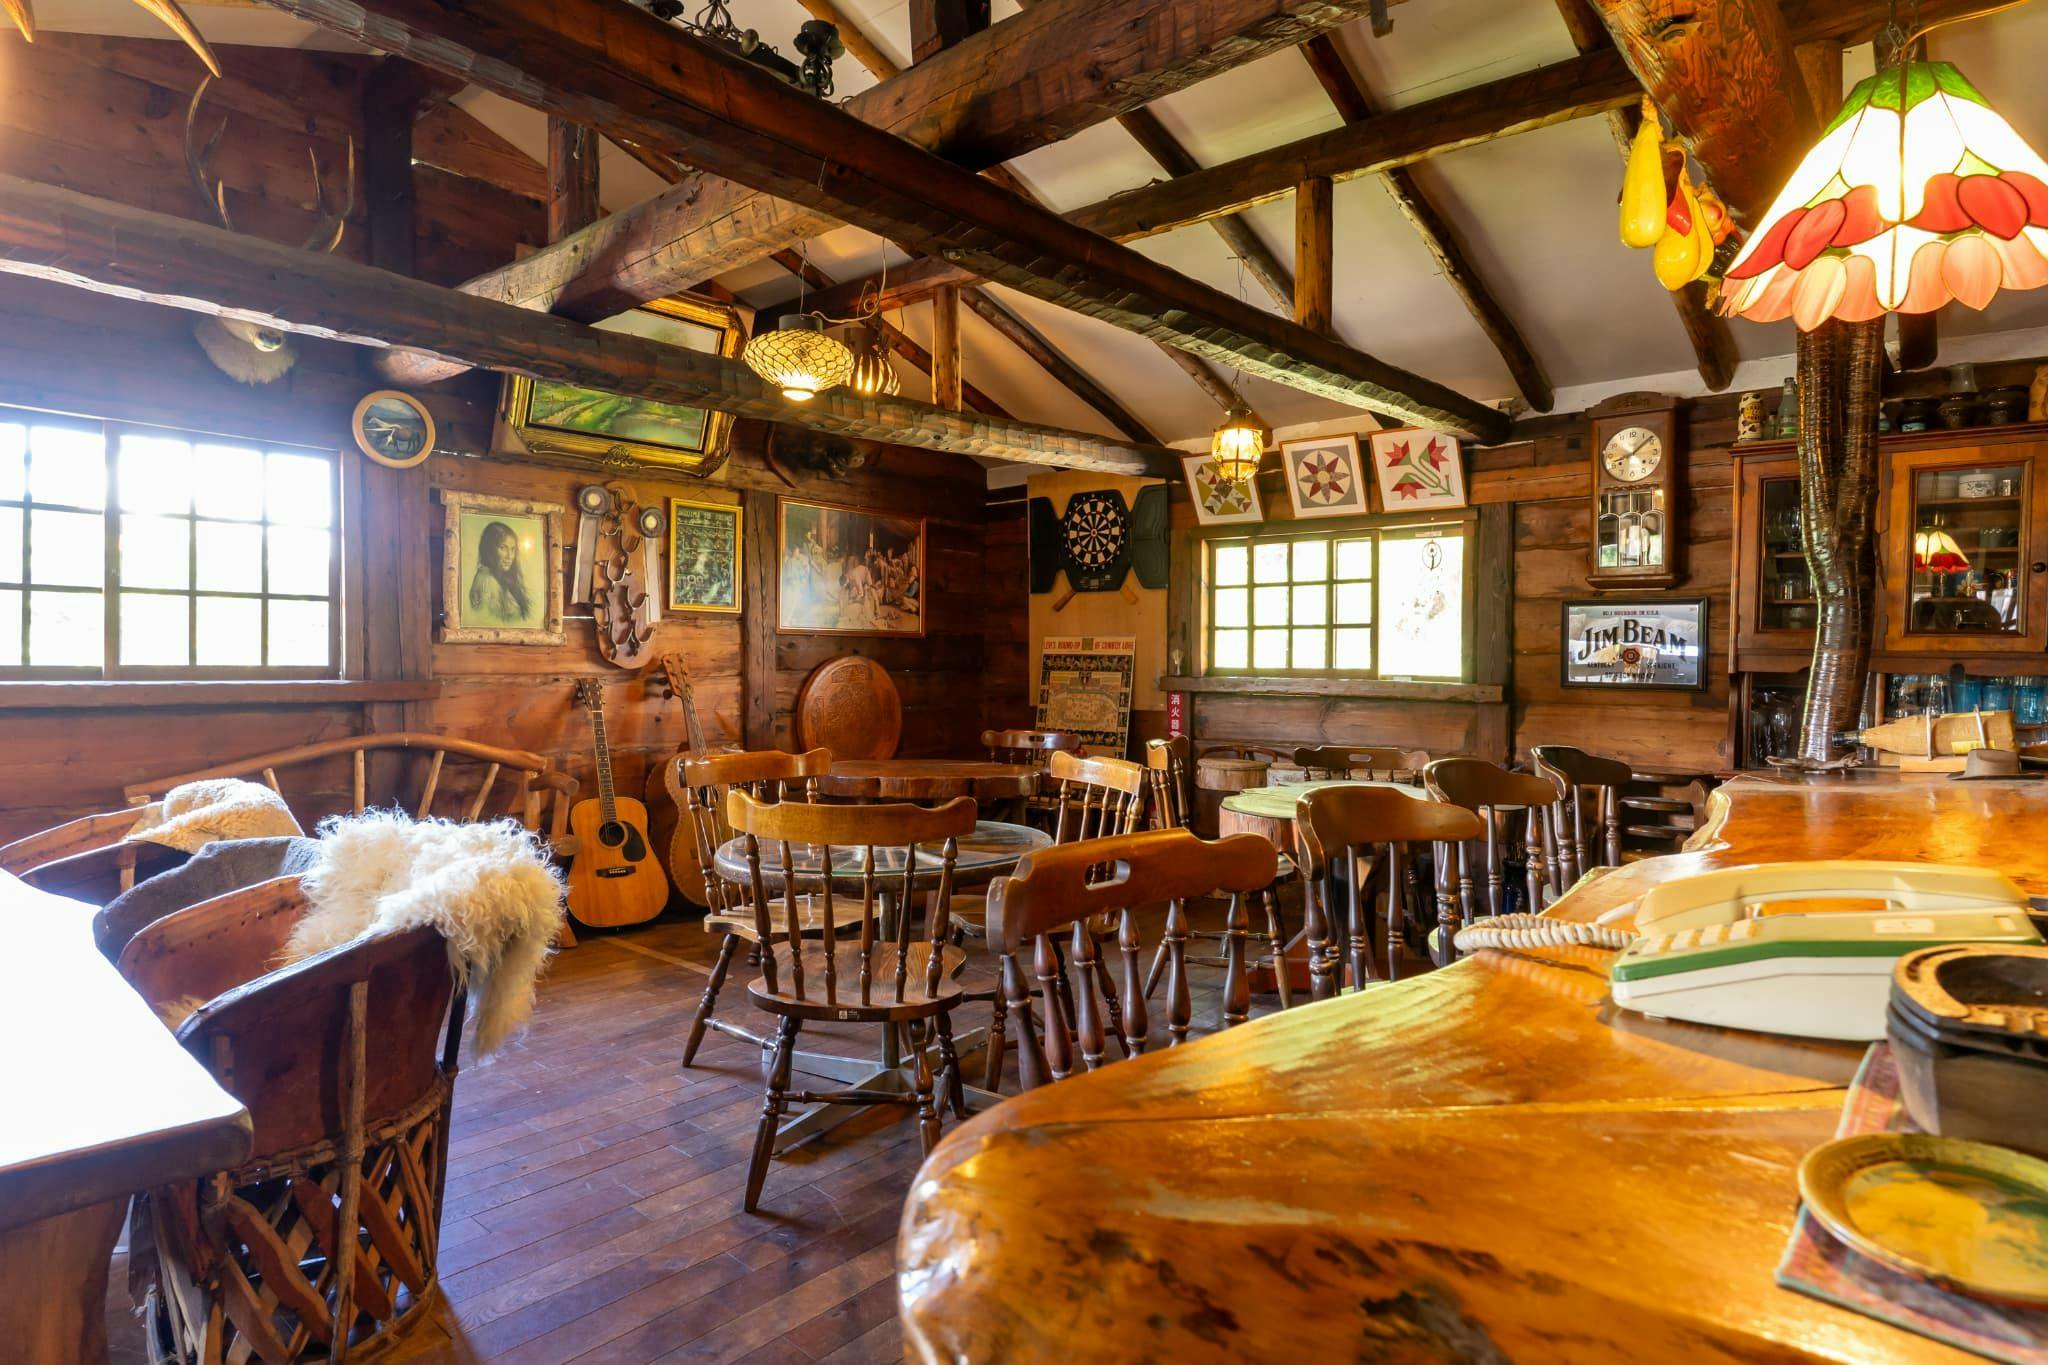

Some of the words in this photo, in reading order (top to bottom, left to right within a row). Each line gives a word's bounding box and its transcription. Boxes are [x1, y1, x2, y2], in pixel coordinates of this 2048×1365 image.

[1578, 626, 1621, 661] JIM
[1622, 618, 1688, 664] BEAM
[1170, 694, 1180, 730] 消火器
